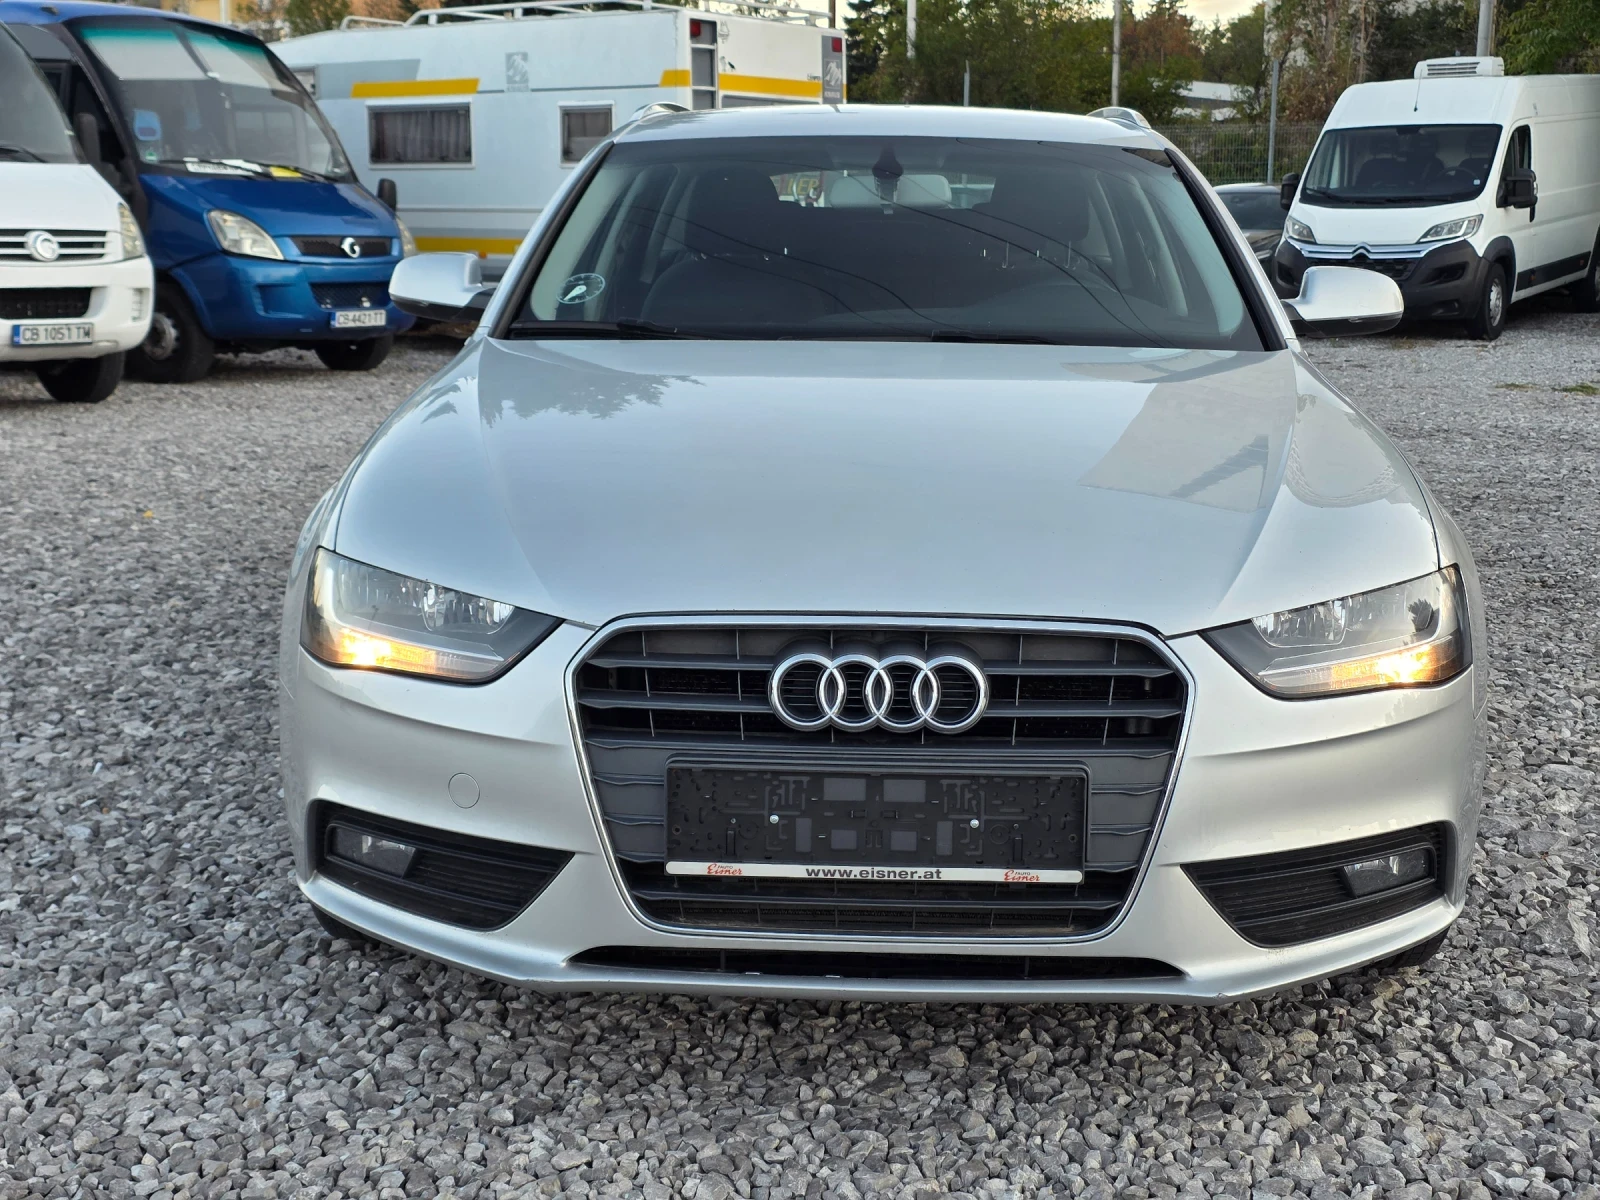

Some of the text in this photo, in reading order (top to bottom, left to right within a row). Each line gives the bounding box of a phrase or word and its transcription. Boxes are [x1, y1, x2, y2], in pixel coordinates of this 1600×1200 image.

[22, 327, 40, 341] CB
[43, 326, 73, 341] 1051
[706, 862, 743, 875] Eisner
[805, 867, 942, 880] www.eisner.at
[1003, 869, 1041, 882] Eisner
